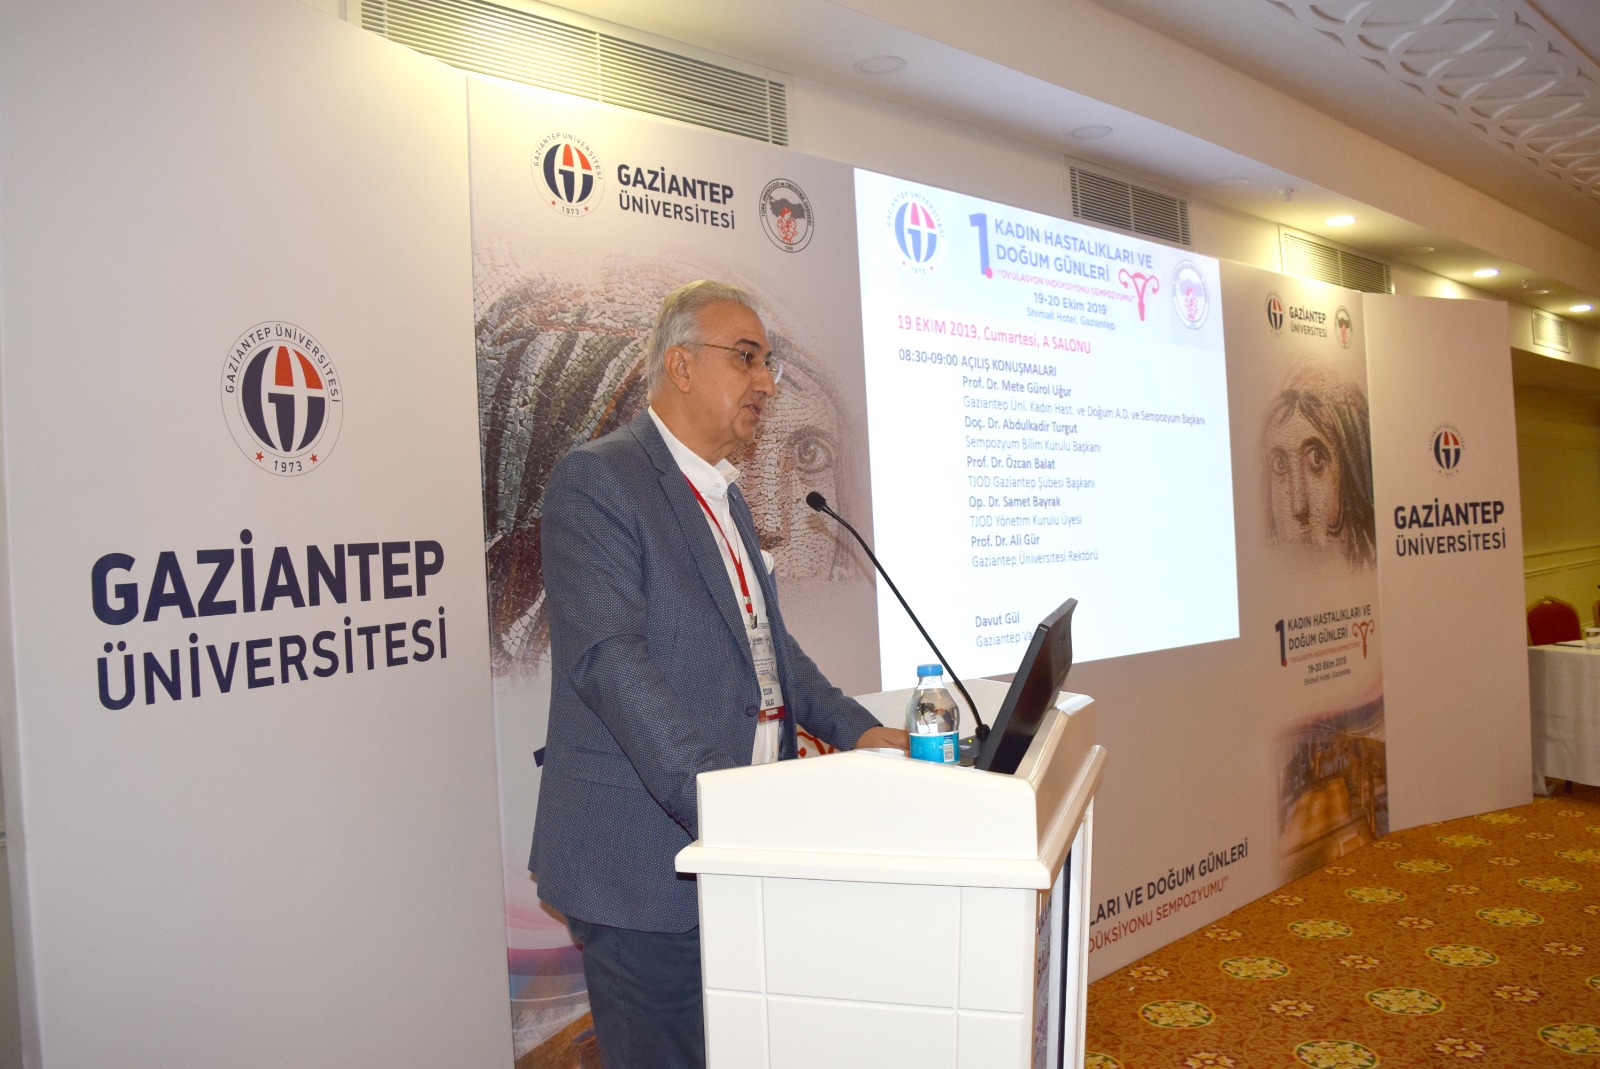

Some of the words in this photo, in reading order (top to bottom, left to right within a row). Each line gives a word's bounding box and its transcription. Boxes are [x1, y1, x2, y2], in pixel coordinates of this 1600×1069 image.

[617, 163, 734, 205] GAZİANTEP
[562, 206, 580, 215] 1973
[619, 190, 735, 231] ÜNİVERSİTESİ
[995, 219, 1040, 243] KADIN
[1044, 231, 1134, 265] HASTALIKLARI
[1138, 252, 1153, 269] VE
[996, 244, 1050, 270] DOĞUM
[1054, 256, 1110, 282] GÜNLERİ
[1033, 292, 1060, 307] 19-20
[1062, 297, 1085, 311] Ekim
[1087, 301, 1107, 315] 2019
[1289, 305, 1327, 324] GAZİANTEP
[897, 314, 913, 331] 19
[915, 317, 946, 335] EKİM
[950, 321, 981, 341] 2019,
[983, 326, 1040, 348] Cumartesi,
[1042, 337, 1051, 350] A
[1052, 338, 1091, 354] SALONU
[1290, 321, 1328, 338] ÜNİVERSİTESİ
[225, 325, 272, 394] GAZİANTEP
[275, 324, 341, 403] ÜNİVERSİTESİ
[898, 348, 958, 367] 08:30-09:00
[961, 355, 990, 372] AÇILIŞ
[992, 358, 1057, 377] KONUŞMALARI
[962, 375, 984, 390] Prof.
[986, 378, 1000, 391] Dr.
[1001, 379, 1025, 393] Mete
[1027, 381, 1050, 395] Gürol
[1052, 384, 1073, 399] Uğur
[963, 395, 1009, 412] Gaziantep
[1011, 398, 1028, 412] Üni.
[1029, 400, 1051, 414] Kadın
[1053, 402, 1074, 416] Hast.
[1076, 406, 1086, 416] ve
[1087, 405, 1114, 420] Doğum
[1131, 410, 1140, 420] ve
[1141, 410, 1181, 425] Sempozyum
[1182, 413, 1206, 427] Başkanı
[964, 415, 985, 431] Doç.
[988, 417, 1001, 430] Dr.
[1002, 417, 1049, 432] Abdulkadir
[1051, 420, 1078, 436] Turgut
[965, 435, 1020, 452] Sempozyum
[1021, 437, 1042, 451] Bilim
[1044, 439, 1071, 452] Kurulu
[1072, 440, 1101, 455] Başkanı
[273, 460, 303, 473] 1973
[966, 455, 989, 469] Prof.
[991, 456, 1003, 468] Dr.
[1005, 454, 1032, 470] Özcan
[1034, 458, 1056, 470] Balat
[968, 475, 990, 489] TJOD
[993, 475, 1036, 491] Gaziantep
[1037, 476, 1065, 491] Şubesi
[1066, 476, 1095, 491] Başkanı
[968, 496, 986, 511] Op.
[988, 496, 1001, 508] Dr.
[1003, 495, 1031, 508] Samet
[1033, 495, 1061, 509] Bayrak
[1394, 497, 1505, 529] GAZİANTEP
[970, 514, 993, 529] TJOD
[995, 514, 1030, 528] Yönetim
[1032, 513, 1059, 526] Kurulu
[1060, 512, 1082, 528] Üyesi
[971, 534, 993, 549] Prof.
[995, 535, 1008, 547] Dr.
[1010, 534, 1022, 546] Ali
[1024, 533, 1040, 546] Gür
[1395, 527, 1507, 557] ÜNİVERSİTESİ
[972, 553, 1017, 569] Gaziantep
[1019, 550, 1067, 565] Üniversitesi
[1068, 549, 1099, 562] Rektörü
[91, 528, 445, 626] GAZİANTEP
[975, 613, 1002, 628] Davut
[1004, 611, 1020, 626] Gül
[1287, 615, 1312, 631] KADIN
[1313, 606, 1361, 626] HASTALIKLARI
[1362, 604, 1371, 617] VE
[976, 631, 1018, 648] Gaziantep
[1288, 633, 1317, 651] DOĞUM
[1318, 624, 1348, 644] GÜNLERİ
[97, 605, 447, 711] ÜNİVERSİTESİ
[1124, 886, 1143, 909] VE
[1147, 864, 1195, 901] DOĞUM
[1199, 837, 1248, 877] GÜNLERİ
